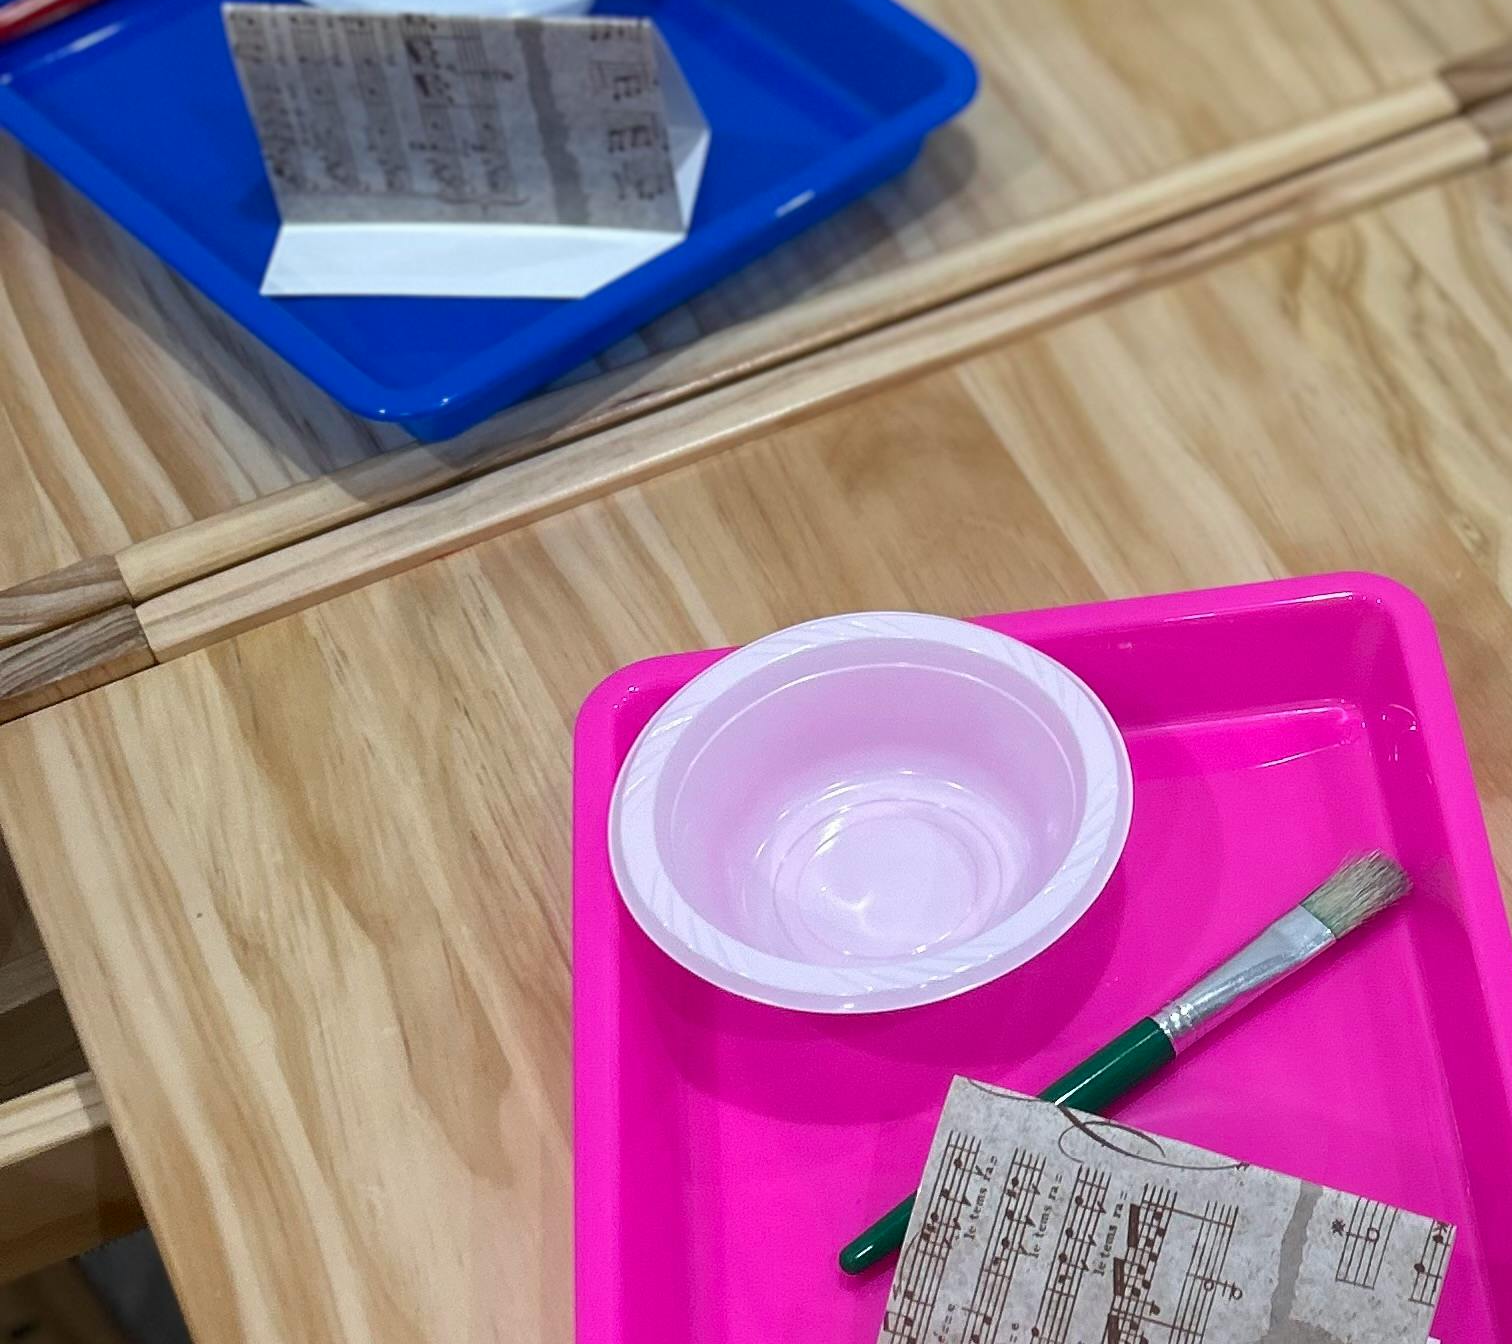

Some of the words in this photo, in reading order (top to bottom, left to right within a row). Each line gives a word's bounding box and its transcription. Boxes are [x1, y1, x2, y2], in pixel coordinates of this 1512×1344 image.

[970, 1185, 987, 1220] tems
[1034, 1202, 1053, 1239] tems
[1100, 1223, 1118, 1259] tems
